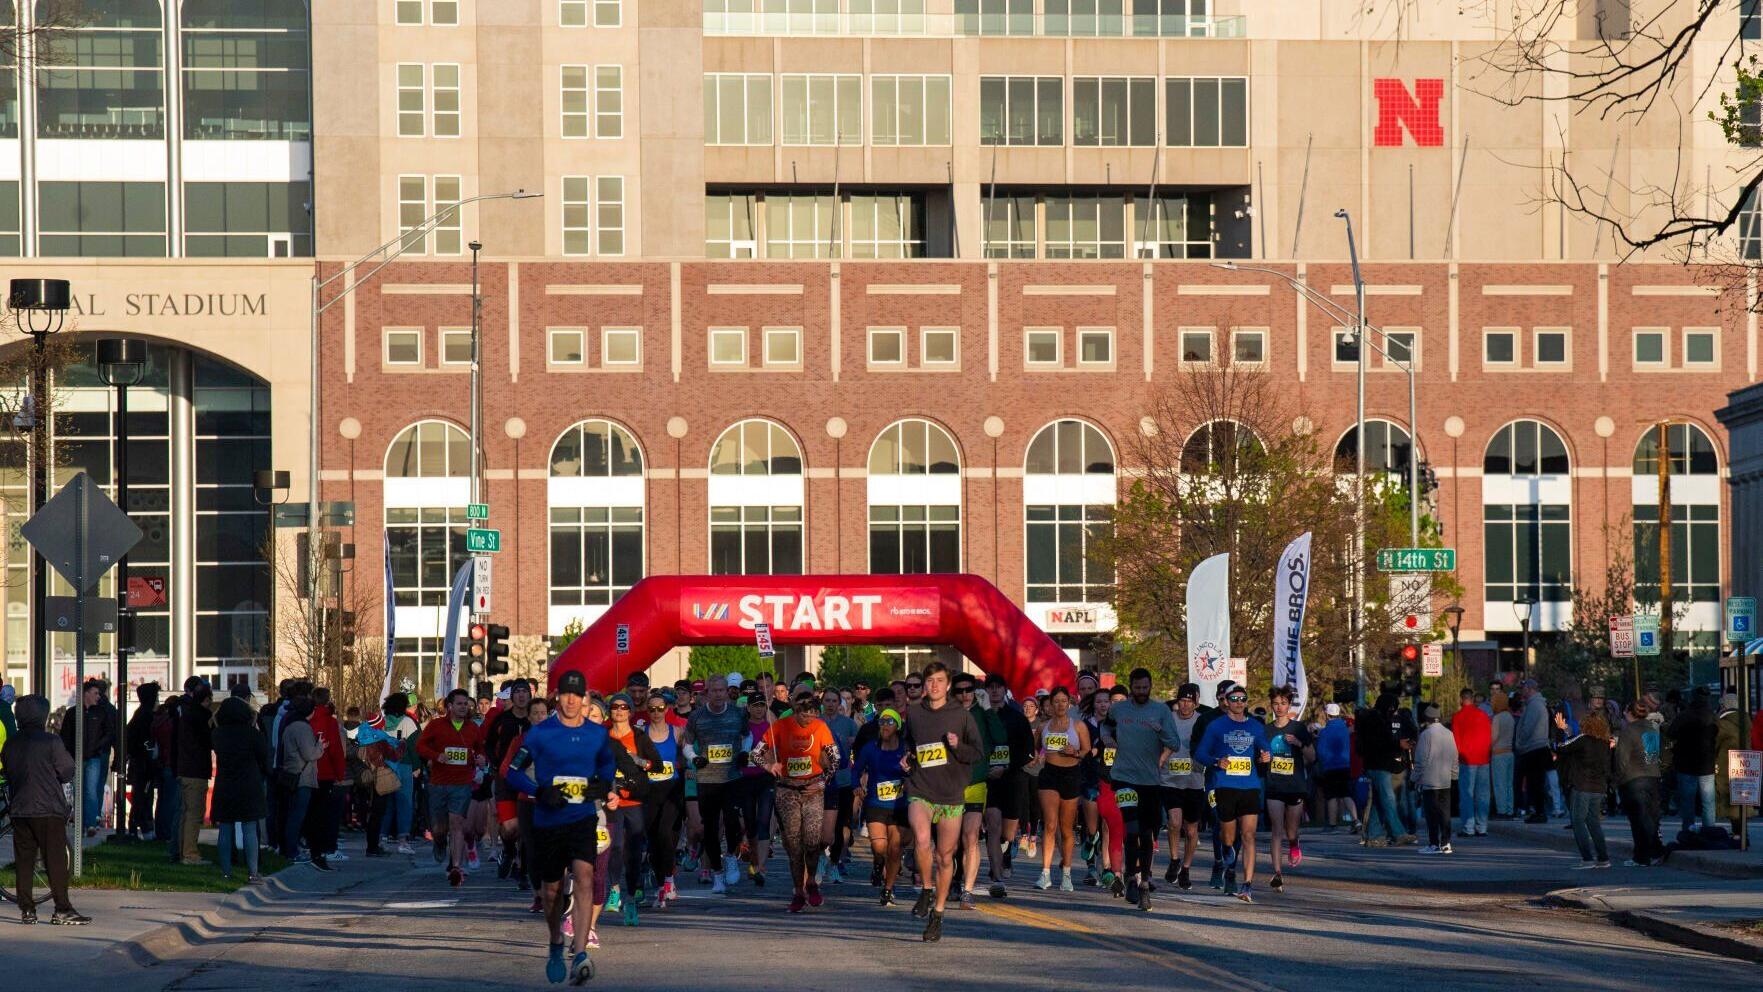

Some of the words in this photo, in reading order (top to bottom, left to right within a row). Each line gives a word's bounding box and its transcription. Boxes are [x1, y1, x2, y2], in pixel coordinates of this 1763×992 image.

[1374, 78, 1444, 146] N
[125, 293, 268, 316] STADIUM
[470, 532, 486, 549] Vine
[487, 533, 496, 549] St
[479, 560, 488, 571] NO
[1397, 551, 1427, 568] 14th
[1433, 551, 1449, 569] St
[1288, 553, 1305, 624] BROS.
[1401, 580, 1420, 591] NO
[737, 594, 882, 630] START
[1051, 611, 1092, 623] NAPL
[757, 628, 770, 650] 1:45
[1615, 632, 1630, 641] BUS
[918, 748, 943, 764] 722
[1228, 762, 1251, 771] 1458
[1272, 761, 1293, 771] 1627
[1740, 760, 1750, 768] NO
[1731, 769, 1759, 777] PARKING
